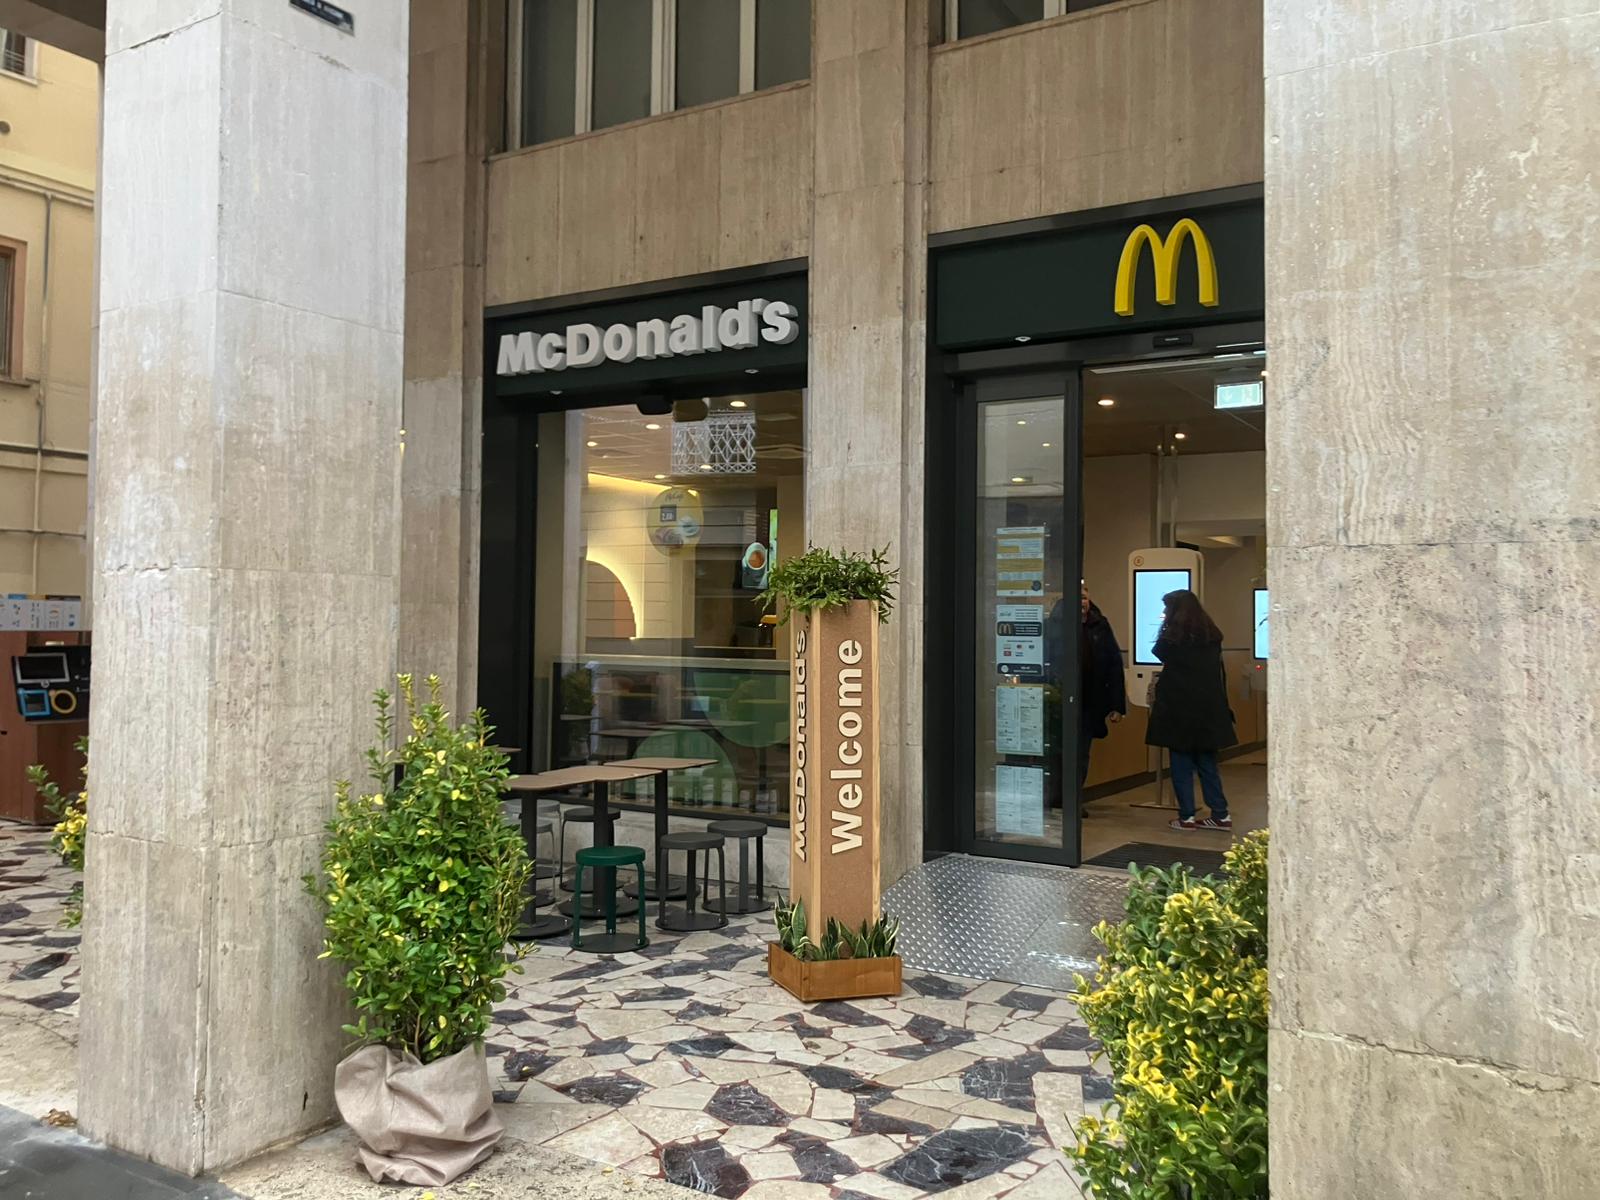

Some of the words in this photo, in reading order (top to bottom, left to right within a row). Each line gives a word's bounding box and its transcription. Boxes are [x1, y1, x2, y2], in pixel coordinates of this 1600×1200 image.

[496, 298, 799, 376] McDonald's
[794, 629, 808, 863] McDonald's
[830, 639, 863, 855] Welcome
